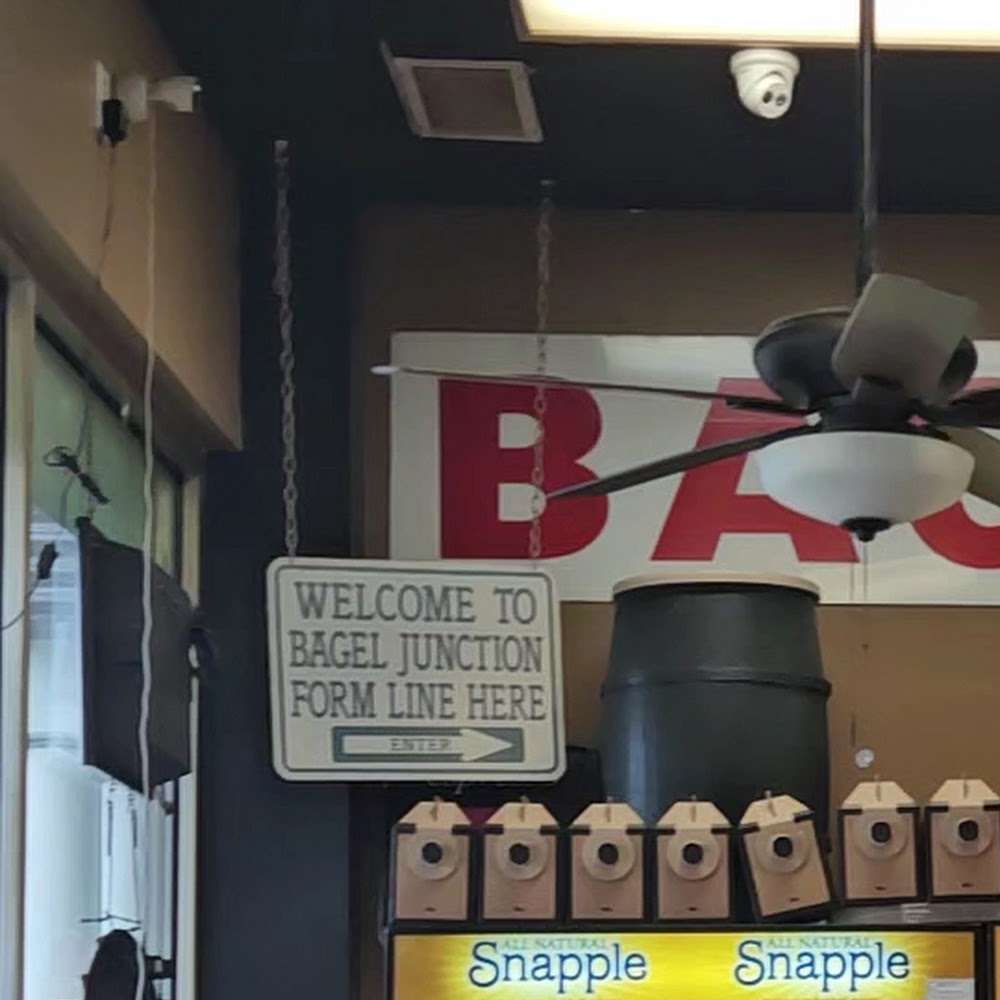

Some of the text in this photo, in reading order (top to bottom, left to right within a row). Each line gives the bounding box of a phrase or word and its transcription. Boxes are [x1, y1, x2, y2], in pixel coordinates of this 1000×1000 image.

[293, 581, 537, 625] WELCOME TO
[288, 629, 544, 677] BAGEL JUNCTION
[290, 679, 547, 722] FORM LINE HERE
[390, 737, 450, 751] ENTER
[503, 938, 607, 950] ALL NATURAL
[768, 937, 873, 949] ALL NATURAL
[468, 941, 648, 994] Snapple
[734, 939, 911, 992] Snapple
